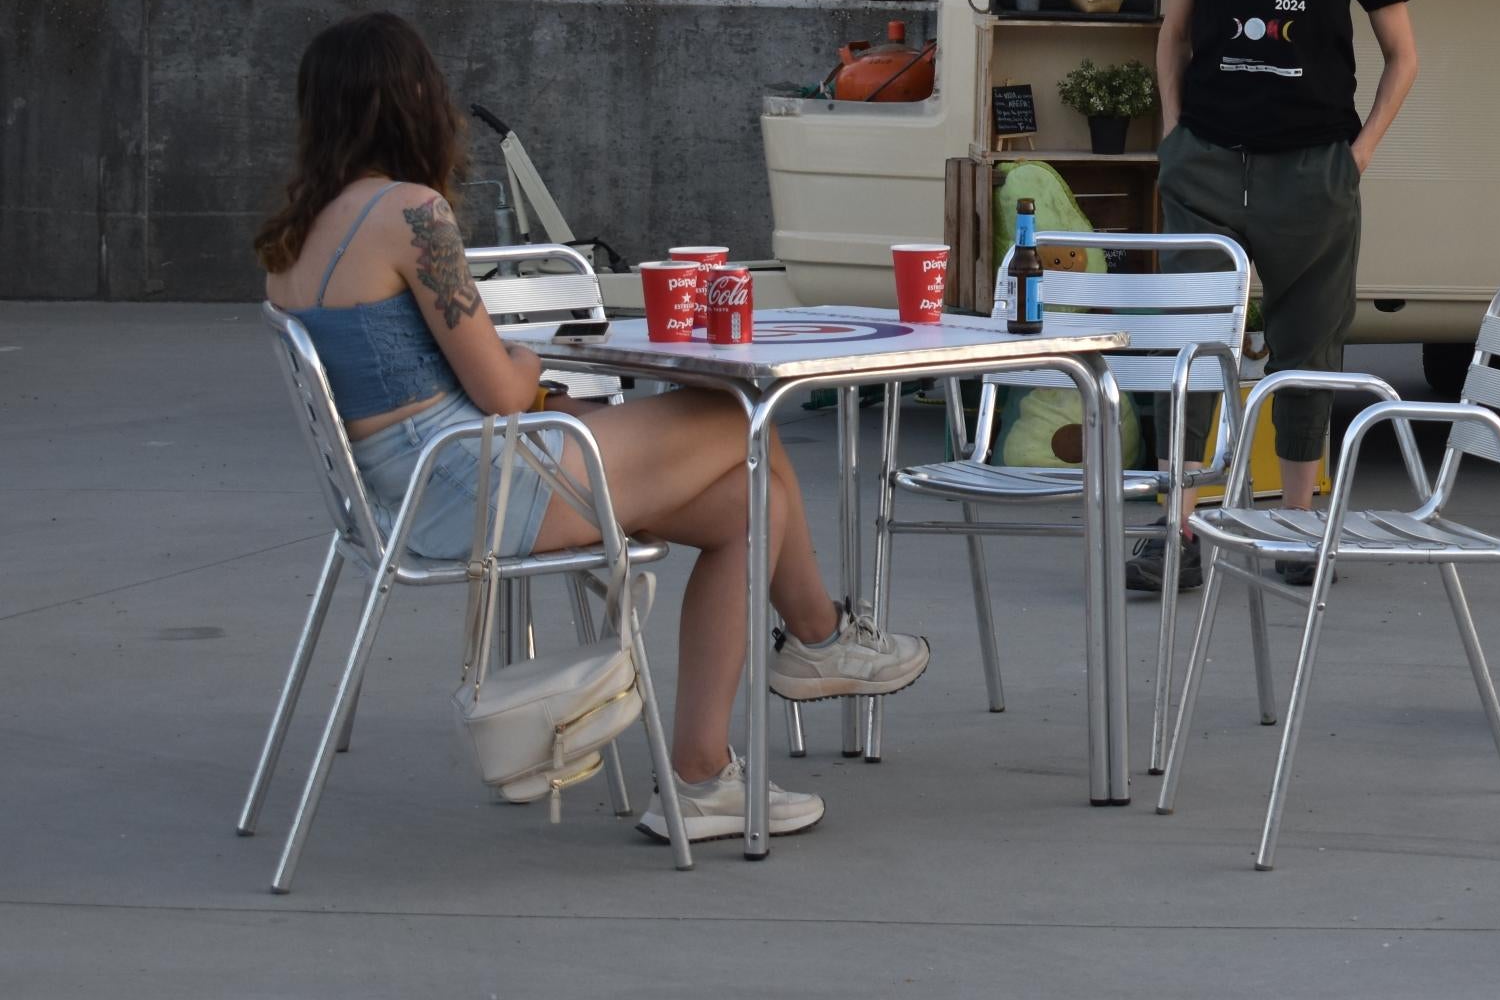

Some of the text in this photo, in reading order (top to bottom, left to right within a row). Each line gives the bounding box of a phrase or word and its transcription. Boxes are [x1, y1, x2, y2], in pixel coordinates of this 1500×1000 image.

[1274, 0, 1306, 12] 2024
[698, 260, 724, 273] apel
[708, 275, 750, 306] Cola
